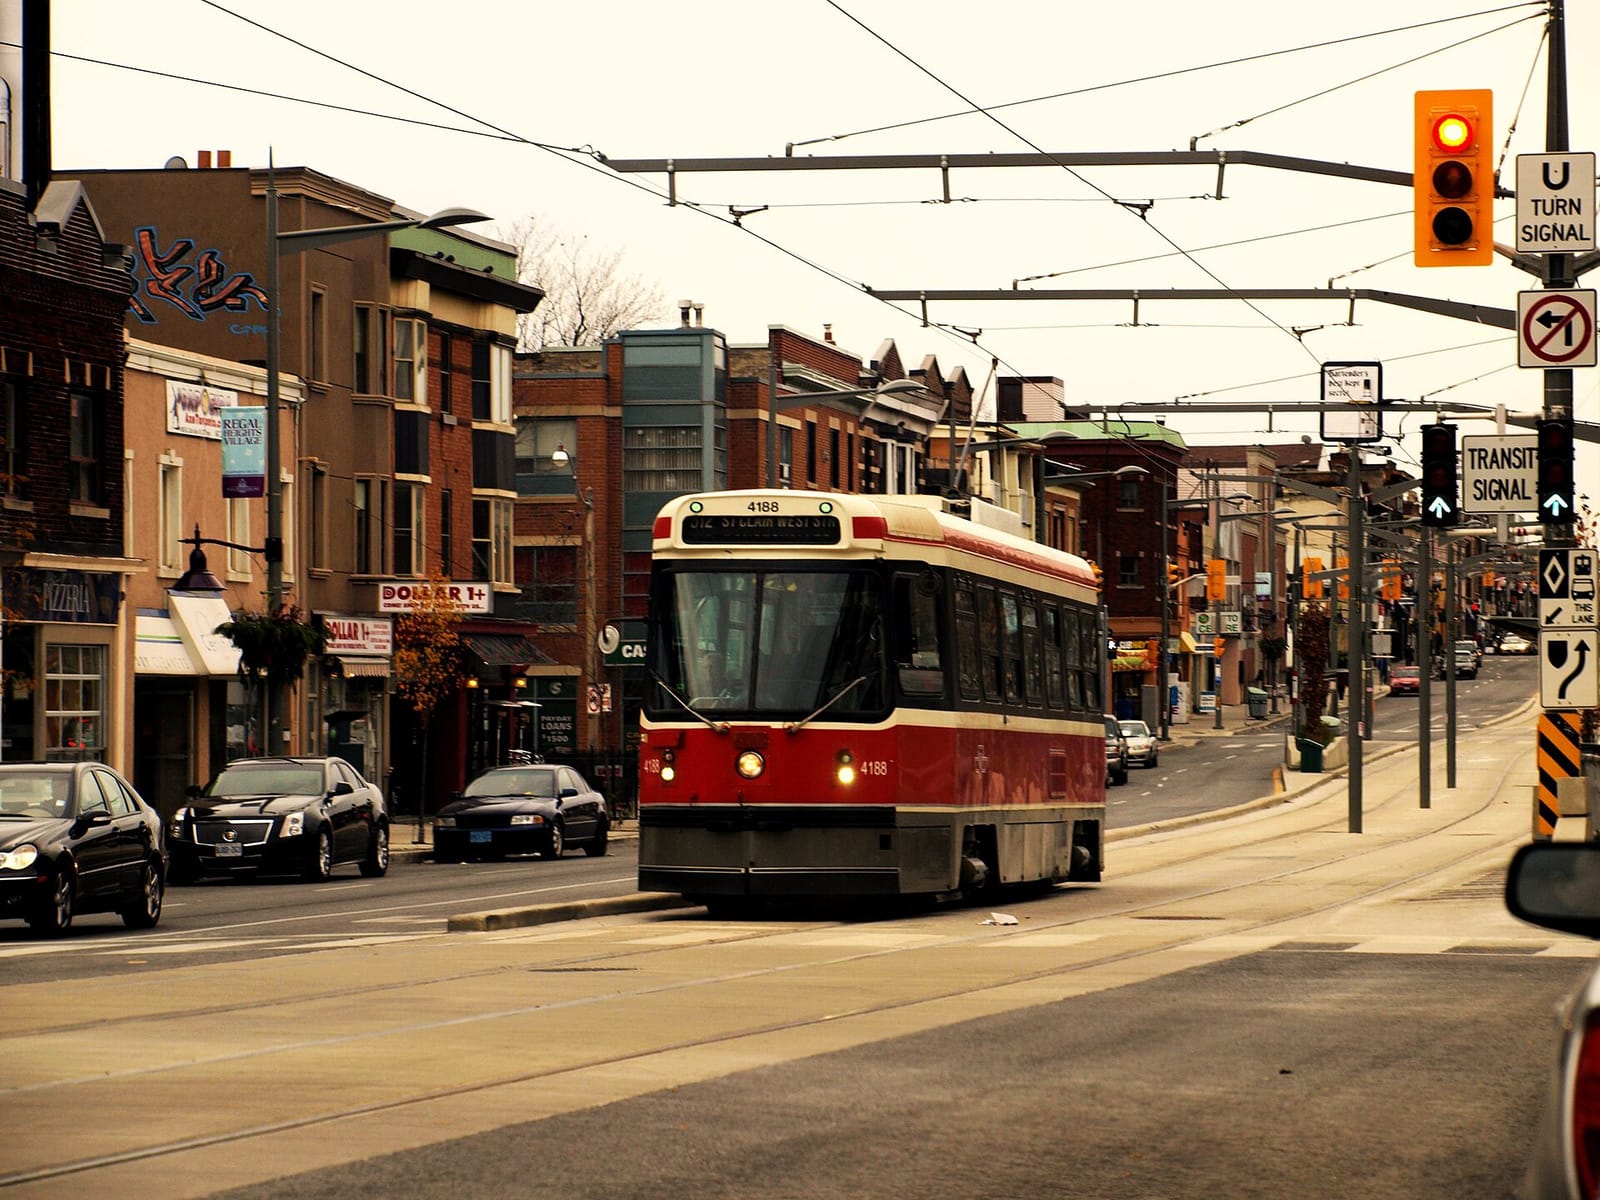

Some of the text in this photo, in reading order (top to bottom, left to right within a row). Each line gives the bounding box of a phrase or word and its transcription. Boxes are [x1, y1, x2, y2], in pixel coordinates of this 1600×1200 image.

[1542, 161, 1570, 191] U
[1531, 198, 1581, 217] TURN
[1521, 223, 1591, 243] SIGNAL
[223, 418, 262, 429] REGAL
[223, 428, 262, 438] HEIGHTS
[223, 437, 262, 446] VILLAGE
[1468, 447, 1537, 470] TRANSIT
[1473, 478, 1532, 501] SIGNAL
[747, 501, 779, 513] 4188
[43, 583, 90, 613] PIZZERIA
[466, 586, 486, 601] 1+
[1574, 603, 1593, 612] THIS
[1572, 614, 1595, 624] LANE
[540, 722, 573, 730] LOANS
[643, 759, 660, 774] 4188
[860, 761, 887, 776] 4188
